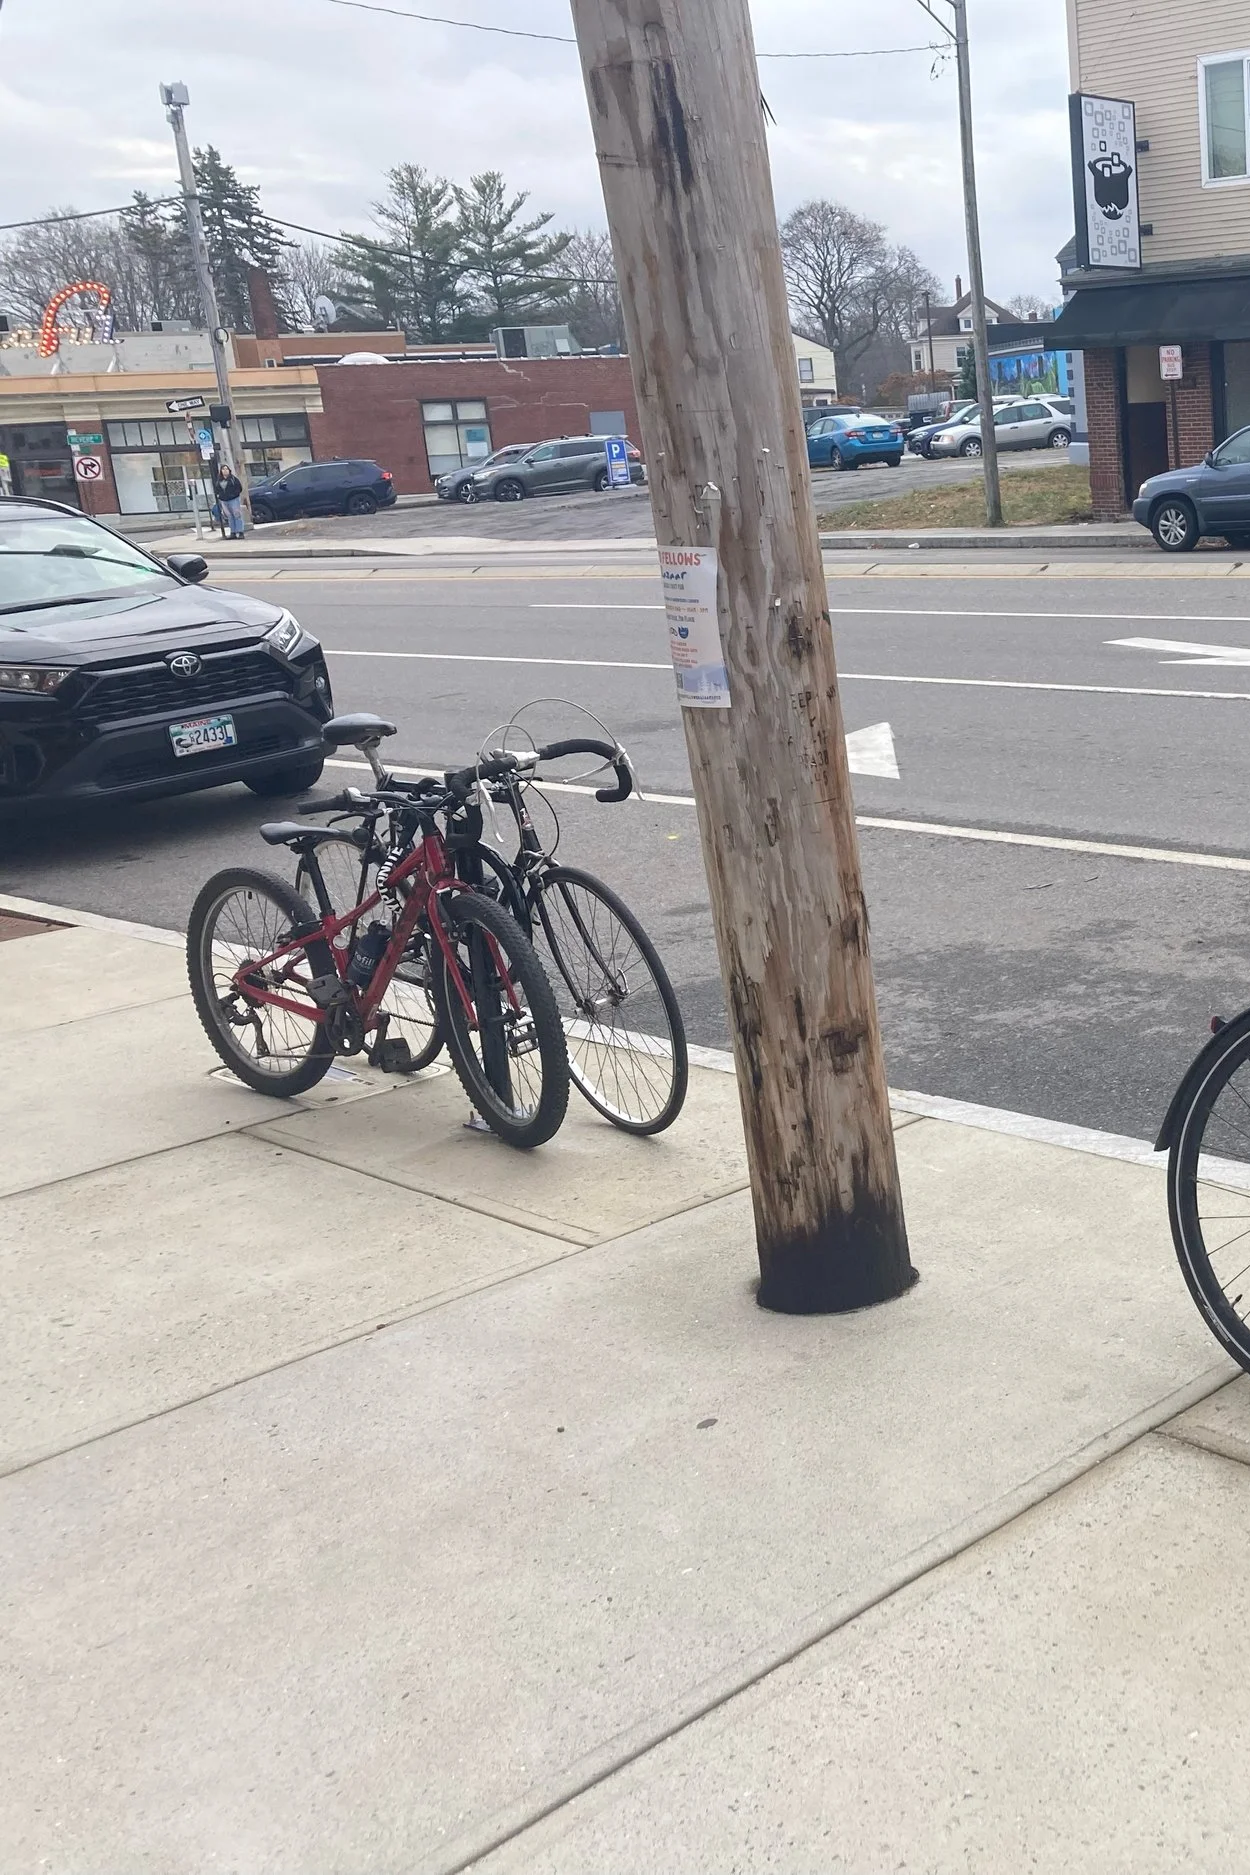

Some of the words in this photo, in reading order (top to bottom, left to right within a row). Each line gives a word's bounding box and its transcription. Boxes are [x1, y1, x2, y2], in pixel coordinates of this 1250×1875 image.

[611, 444, 620, 458] P
[661, 551, 701, 566] FELLOWS
[183, 719, 210, 729] MAINE
